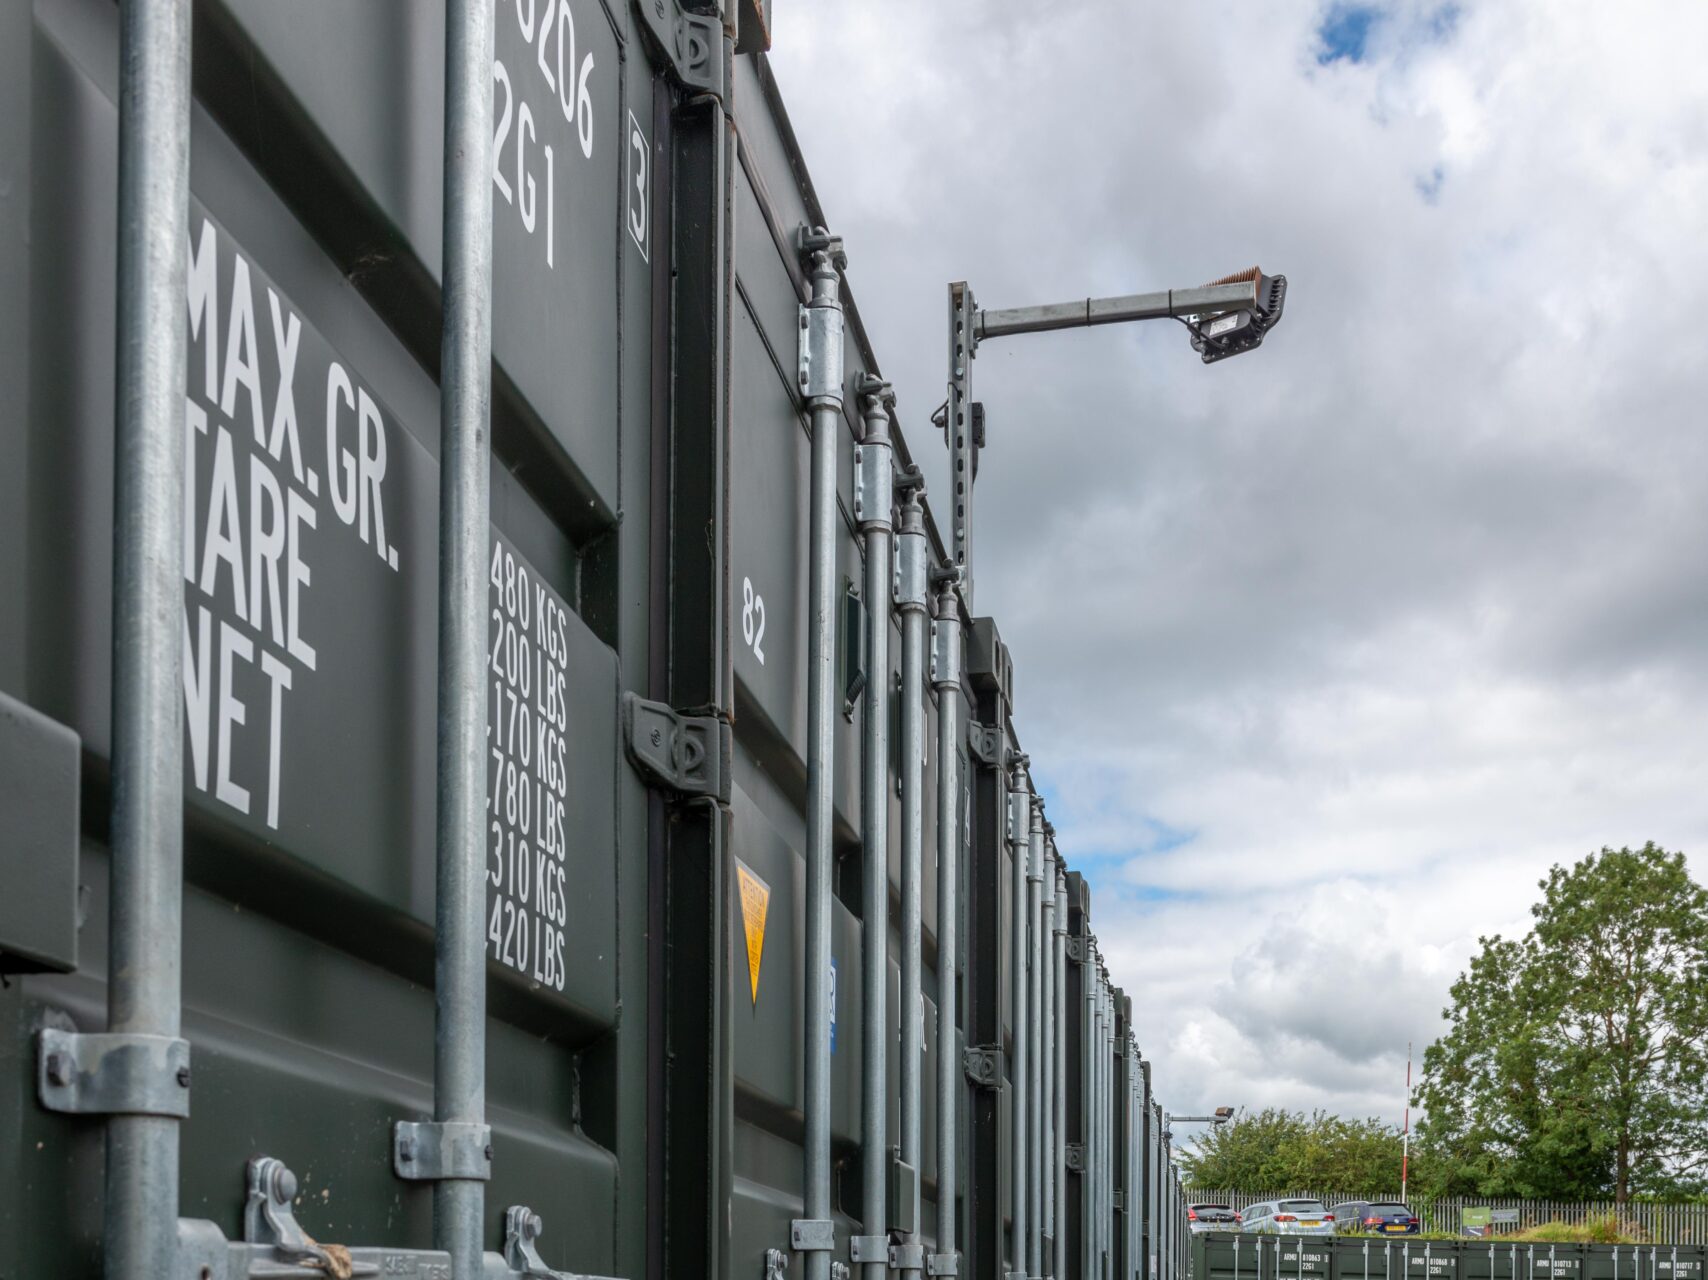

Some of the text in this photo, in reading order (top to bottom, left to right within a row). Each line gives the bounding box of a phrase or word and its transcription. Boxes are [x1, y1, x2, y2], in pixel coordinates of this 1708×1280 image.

[632, 130, 645, 242] 3
[326, 361, 398, 573] GR.
[184, 396, 317, 671] TARE
[536, 582, 567, 670] KGS
[743, 576, 765, 666] 82
[183, 605, 292, 830] NET
[537, 649, 566, 733] LBS
[537, 716, 566, 798] KGS
[537, 783, 565, 862] LBS
[536, 850, 566, 927] KGS
[534, 917, 565, 992] LBS
[1302, 1254, 1320, 1262] 810863
